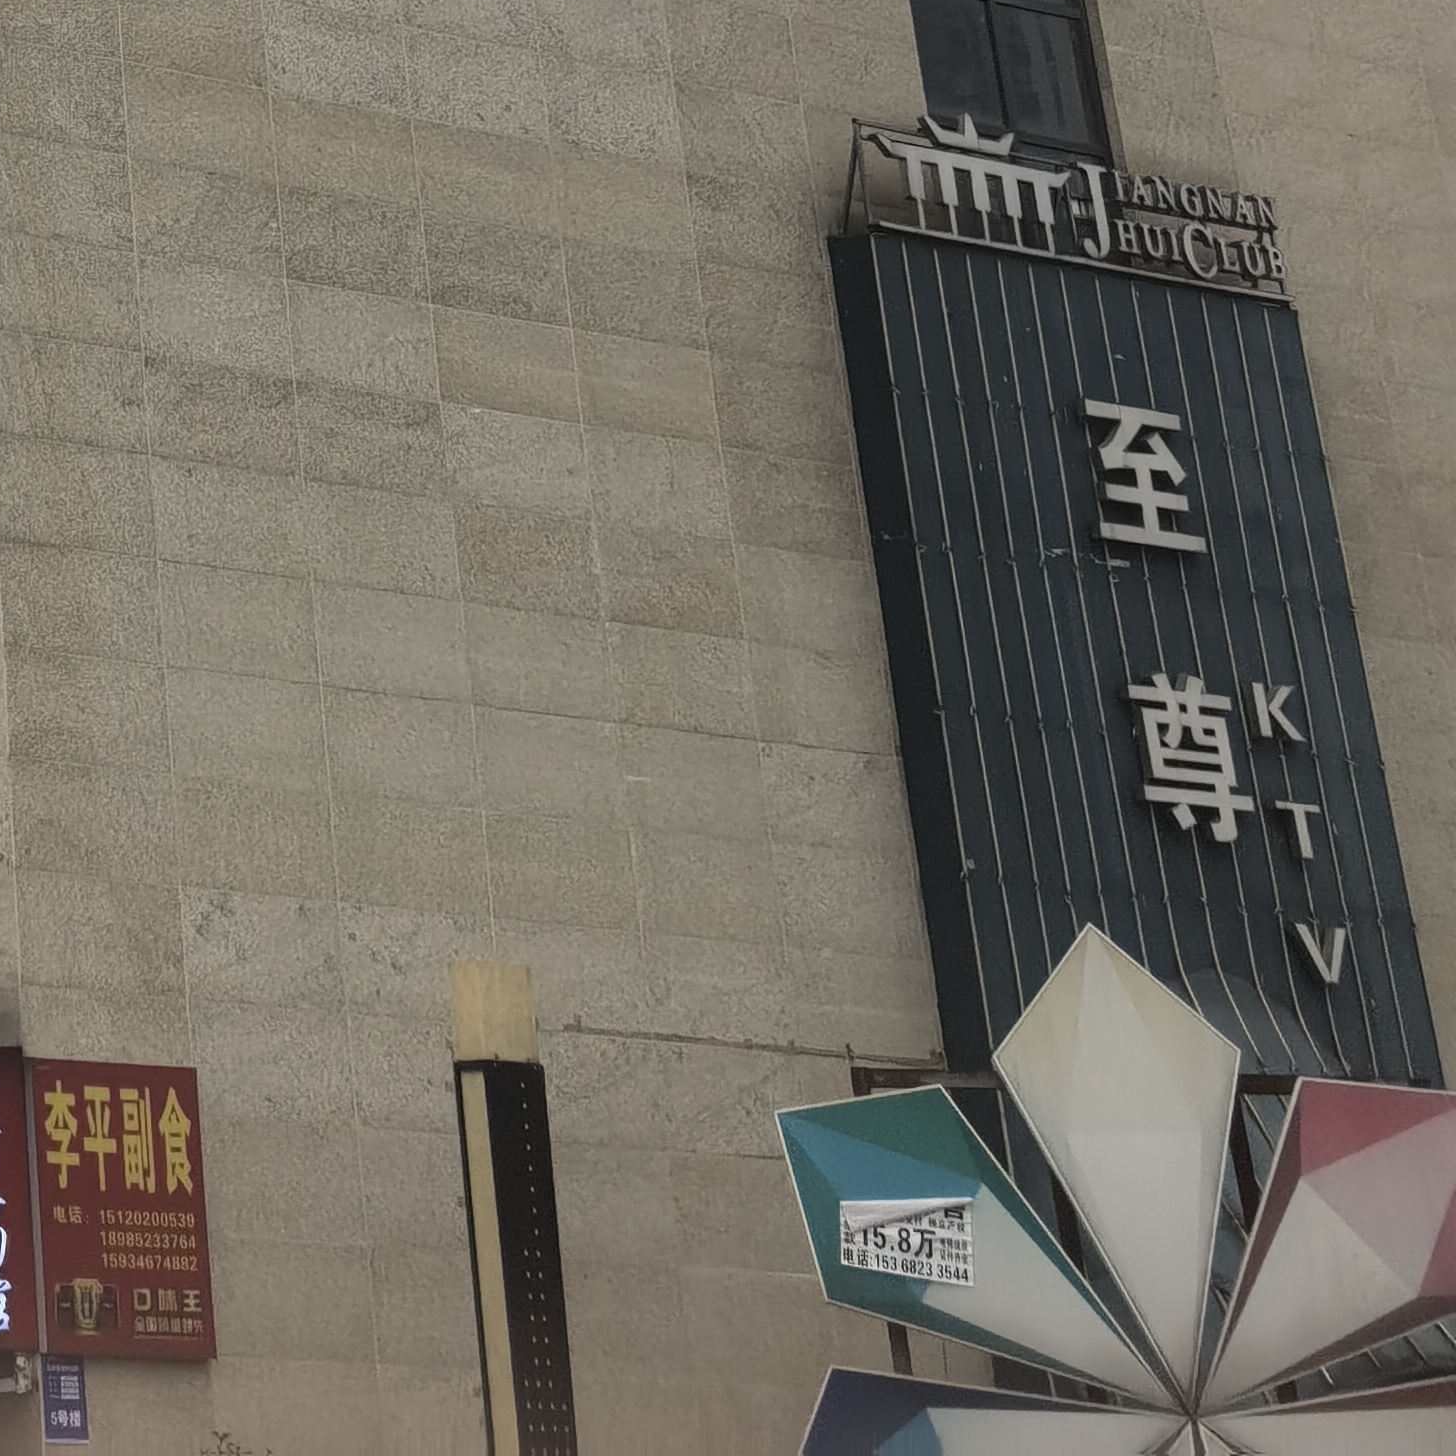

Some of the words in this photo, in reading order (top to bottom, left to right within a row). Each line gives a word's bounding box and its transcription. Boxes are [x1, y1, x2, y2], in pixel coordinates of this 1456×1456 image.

[1084, 398, 1255, 842] 至尊
[43, 1078, 194, 1197] 李平副食
